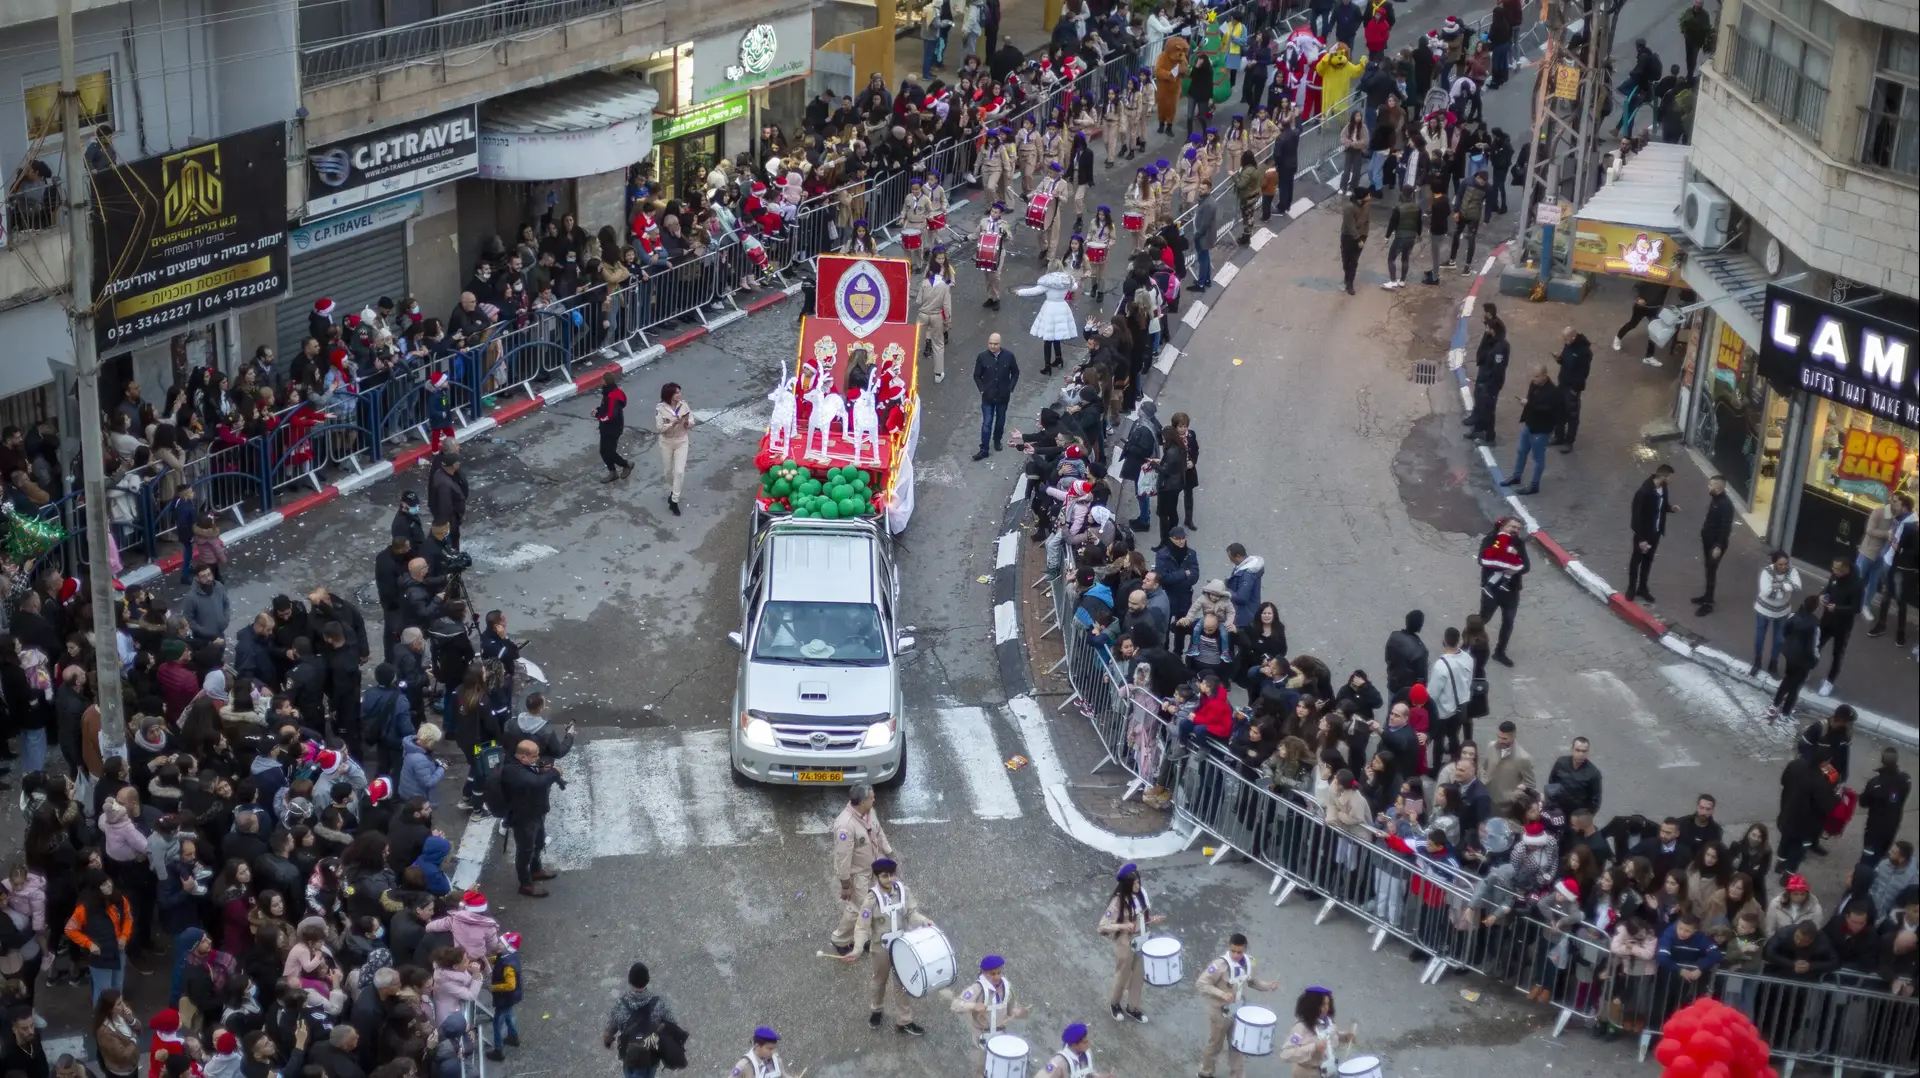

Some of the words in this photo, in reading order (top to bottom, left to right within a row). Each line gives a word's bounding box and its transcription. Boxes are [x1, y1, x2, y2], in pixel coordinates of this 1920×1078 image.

[194, 220, 217, 235] בנייה
[334, 214, 374, 235] TRAVEL
[151, 227, 193, 248] ושיפוצים
[221, 243, 249, 260] בנייה
[167, 253, 211, 277] שיפוצים
[196, 268, 237, 292] הדפסת
[152, 282, 192, 306] תוכניות
[107, 303, 192, 340] 052-3342227
[204, 275, 279, 308] 04-9122020
[1719, 345, 1741, 369] SALE
[1773, 303, 1919, 390] LAM
[1802, 368, 1835, 393] GIFTS
[1841, 380, 1867, 404] THAT
[1872, 392, 1901, 416] MAKE
[1845, 432, 1899, 463] BIG
[1842, 455, 1896, 483] SALE
